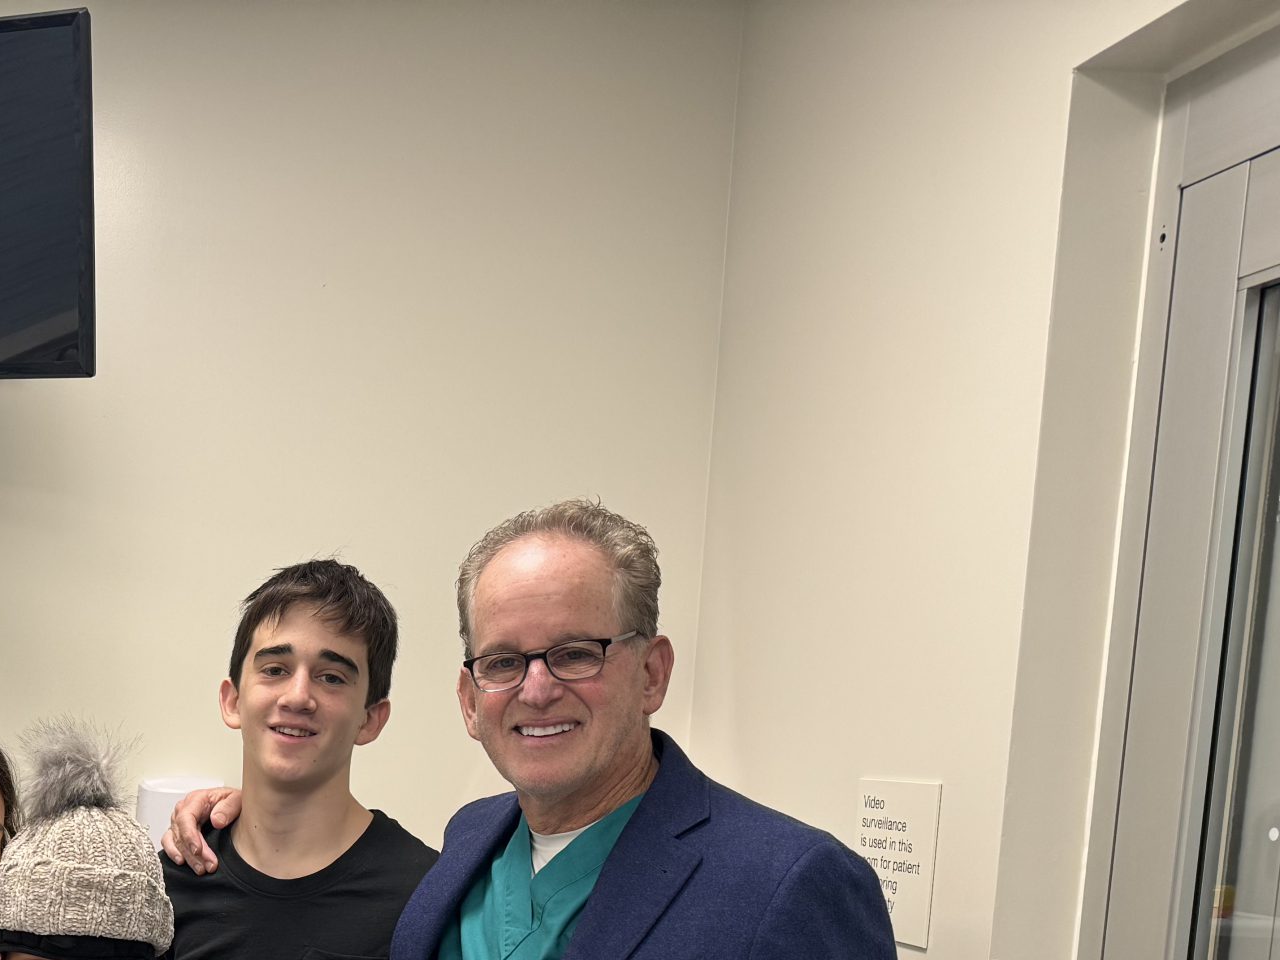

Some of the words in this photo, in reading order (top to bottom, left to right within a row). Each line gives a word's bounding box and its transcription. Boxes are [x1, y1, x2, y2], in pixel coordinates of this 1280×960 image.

[863, 794, 885, 809] Video
[861, 816, 907, 832] surveillance
[860, 833, 867, 847] is
[868, 836, 888, 850] used
[889, 836, 896, 851] in
[898, 838, 913, 853] this
[880, 855, 891, 870] for
[892, 859, 920, 875] patient
